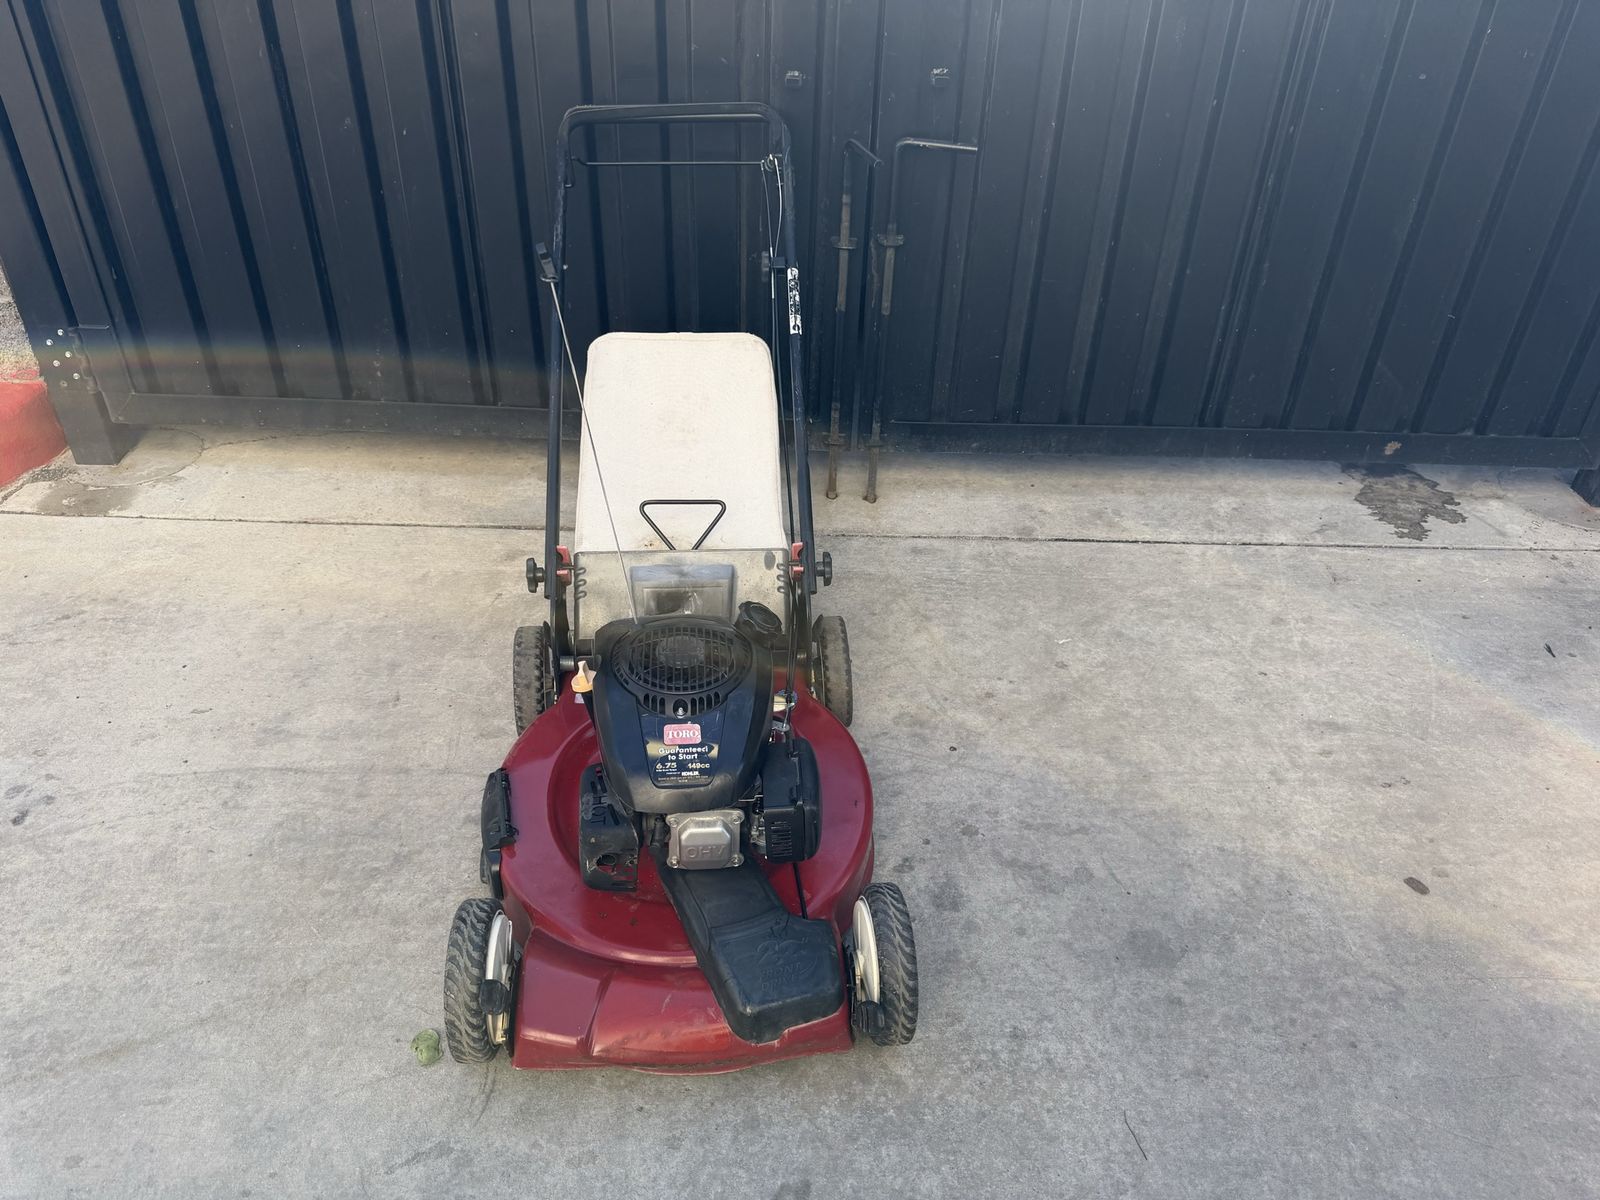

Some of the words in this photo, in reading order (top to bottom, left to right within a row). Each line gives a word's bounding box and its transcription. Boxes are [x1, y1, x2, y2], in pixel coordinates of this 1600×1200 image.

[667, 729, 699, 738] TORO
[658, 745, 709, 754] Guaranteed
[686, 844, 726, 858] OHV
